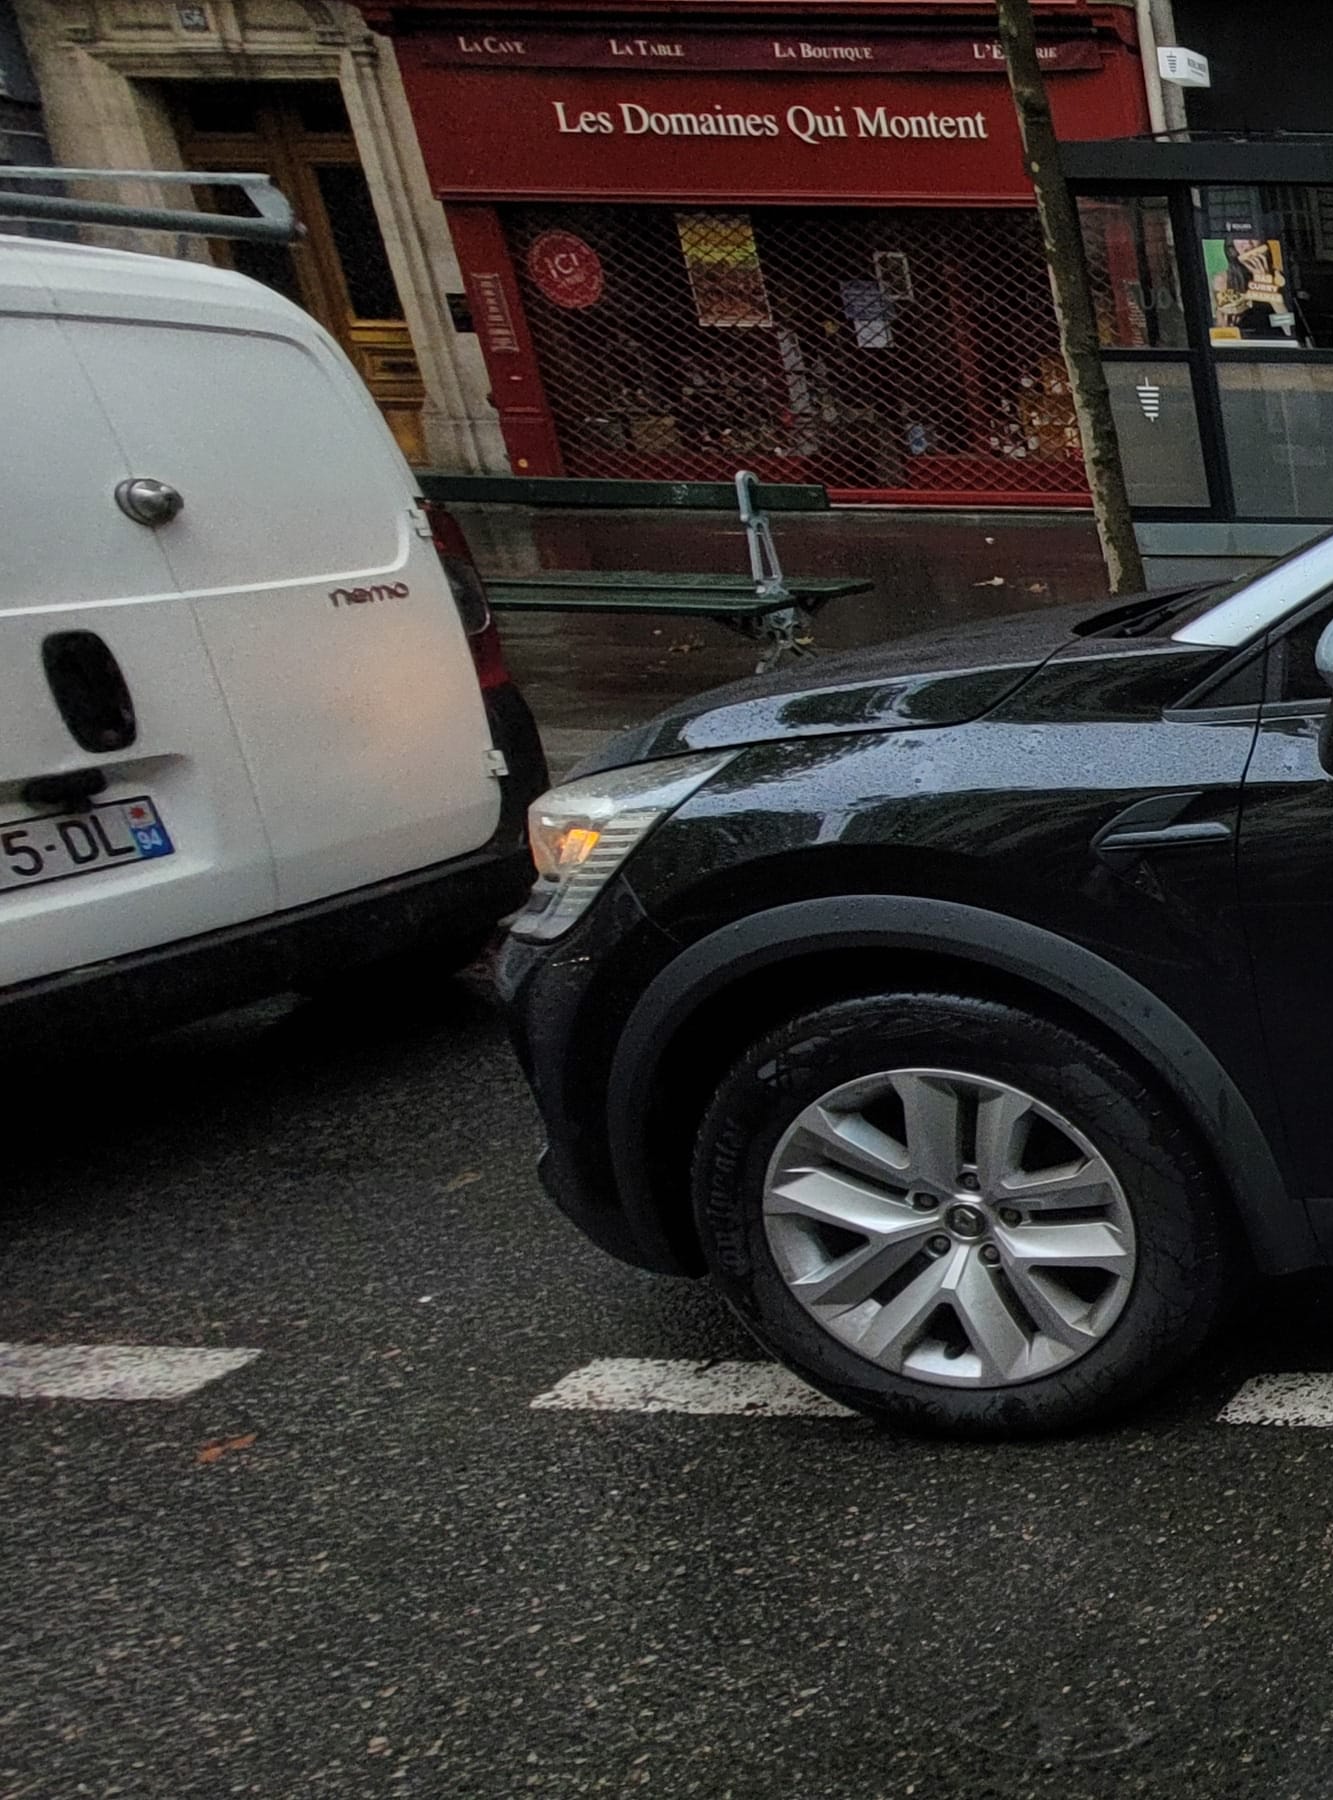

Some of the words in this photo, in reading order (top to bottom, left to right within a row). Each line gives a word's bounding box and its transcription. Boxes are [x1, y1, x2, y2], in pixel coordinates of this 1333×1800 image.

[552, 101, 614, 134] Les
[618, 103, 780, 137] Domaines
[786, 105, 848, 145] Qui
[852, 106, 989, 139] Montent
[328, 581, 410, 608] nemo
[136, 830, 164, 851] 94
